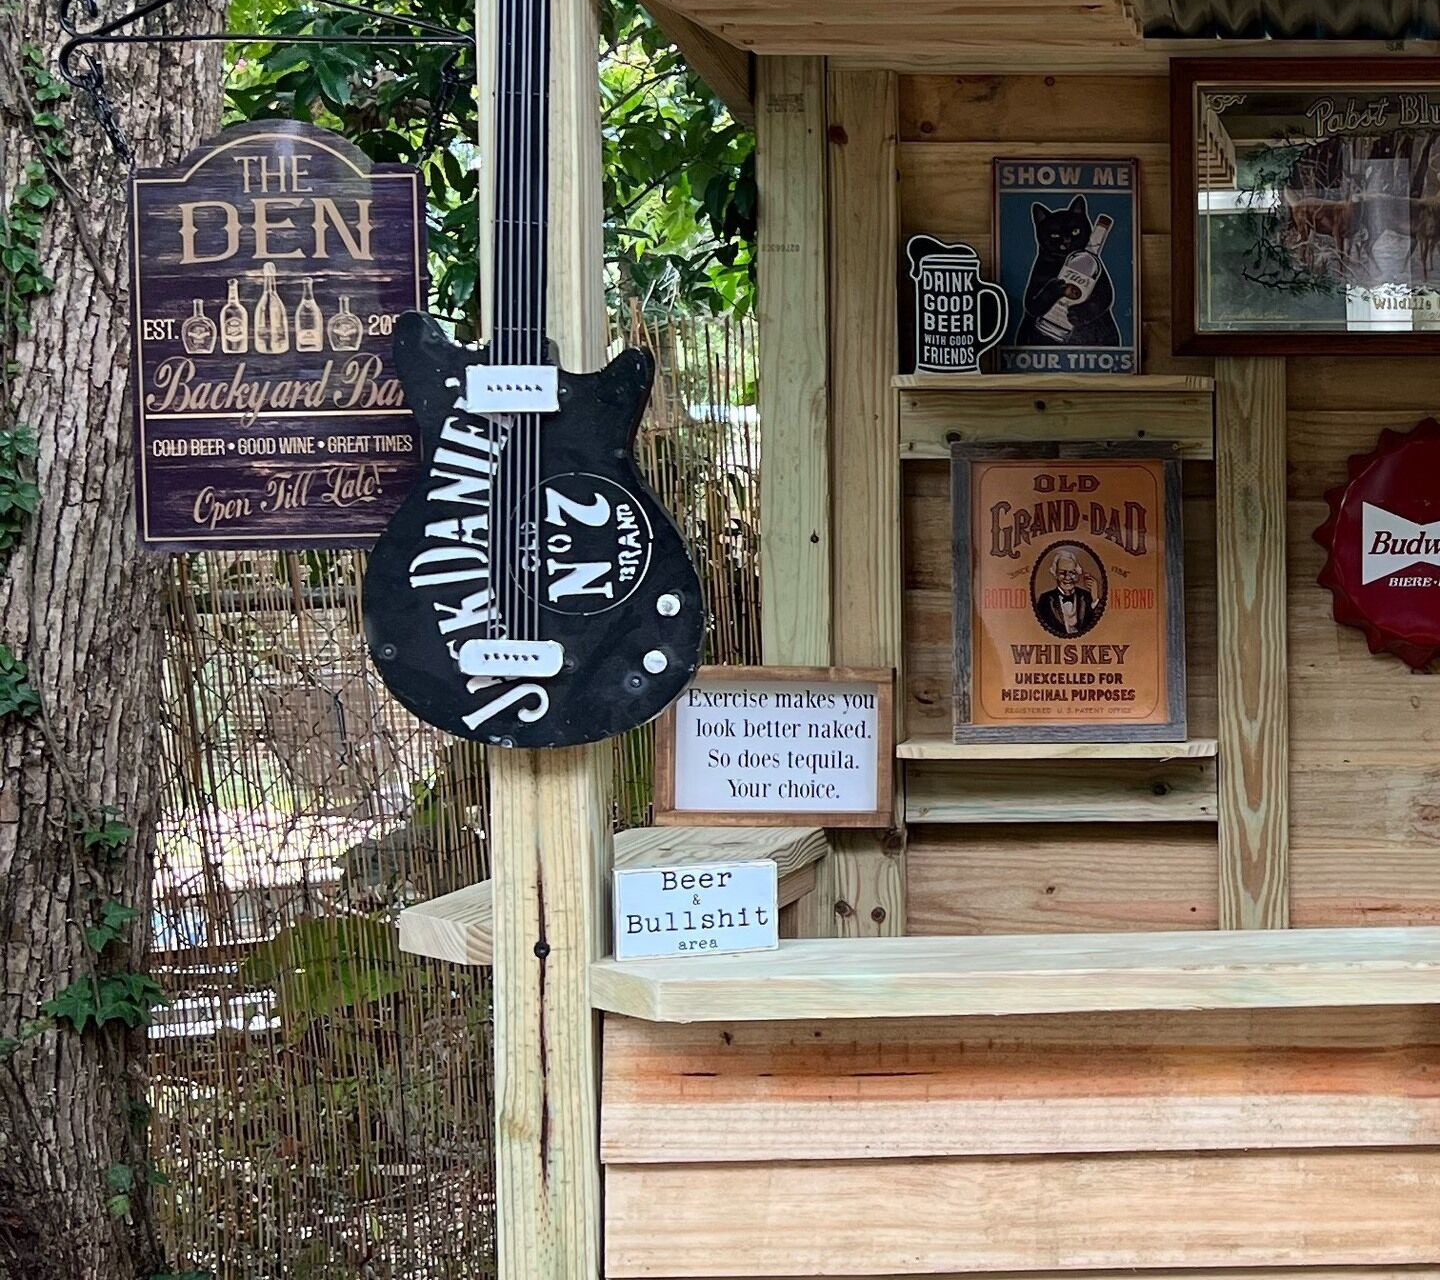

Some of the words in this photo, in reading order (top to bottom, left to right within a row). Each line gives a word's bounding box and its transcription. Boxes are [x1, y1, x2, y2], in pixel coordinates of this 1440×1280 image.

[1306, 96, 1390, 138] Pabst
[232, 154, 314, 194] THE
[1001, 167, 1081, 186] SHOW
[1092, 167, 1129, 186] ME
[177, 197, 374, 266] DEN
[923, 270, 974, 293] DRINK
[923, 293, 973, 312] GOOD
[1373, 295, 1432, 310] Wildlife
[143, 319, 180, 341] EST.
[368, 314, 400, 336] 20
[924, 312, 974, 332] BEER
[924, 333, 947, 346] WITH
[950, 334, 974, 346] GOOD
[924, 346, 974, 365] FRIENDS
[1001, 352, 1064, 369] YOUR
[1067, 353, 1132, 370] TITO'S
[146, 356, 332, 428] Backyard
[152, 440, 188, 457] COLD
[190, 439, 226, 456] BEER
[238, 438, 276, 455] GOOD
[278, 436, 316, 454] WINE
[327, 435, 371, 453] GREAT
[374, 435, 413, 452] TIMES
[1033, 474, 1100, 493] OLD
[193, 485, 252, 530] Open
[260, 470, 312, 514] Till
[319, 463, 384, 508] Late!
[990, 499, 1148, 559] GRAND-DAD
[617, 503, 643, 582] BRAND
[984, 587, 1027, 610] BOTTLED
[1111, 588, 1121, 610] IN
[1124, 588, 1154, 610] BOND
[433, 586, 549, 731] JK
[1011, 643, 1130, 665] WHISKEY
[1014, 672, 1095, 685] UNEXCELLED
[1099, 672, 1123, 685] FOR
[688, 688, 768, 709] Exercise
[775, 690, 836, 709] makes
[843, 692, 875, 715] you
[1001, 689, 1068, 702] MEDICINAL
[1071, 689, 1136, 701] PURPOSES
[696, 719, 737, 738] look
[743, 718, 802, 738] better
[807, 720, 872, 739] naked.
[707, 749, 731, 769] So
[737, 750, 780, 769] does
[787, 750, 859, 774] tequila.
[727, 778, 772, 798] Your
[778, 779, 840, 799] choice.
[661, 870, 732, 891] Beer
[692, 893, 701, 906] &
[626, 906, 769, 935] Bullshit
[678, 938, 718, 951] area
